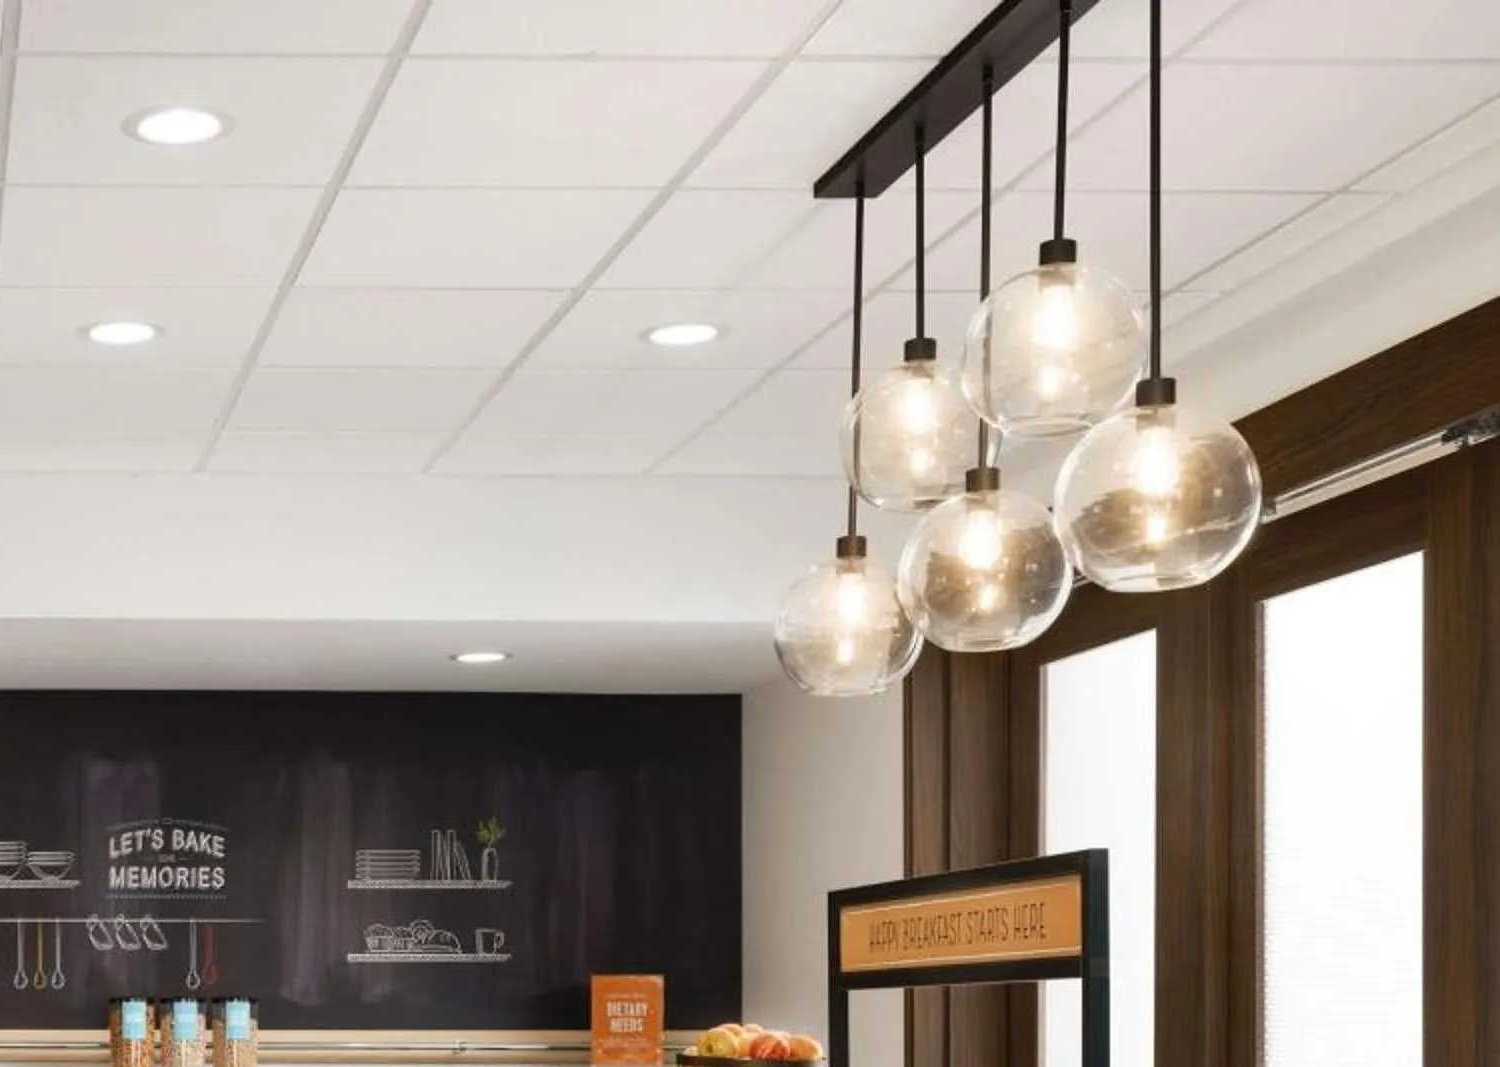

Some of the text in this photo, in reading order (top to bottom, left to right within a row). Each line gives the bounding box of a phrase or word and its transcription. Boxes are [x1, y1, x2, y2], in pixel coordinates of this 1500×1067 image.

[109, 827, 226, 859] LET'S BAKE
[109, 865, 226, 890] MEMORIES
[869, 901, 1047, 953] HAPPY BREAKFAST STARTS HERE
